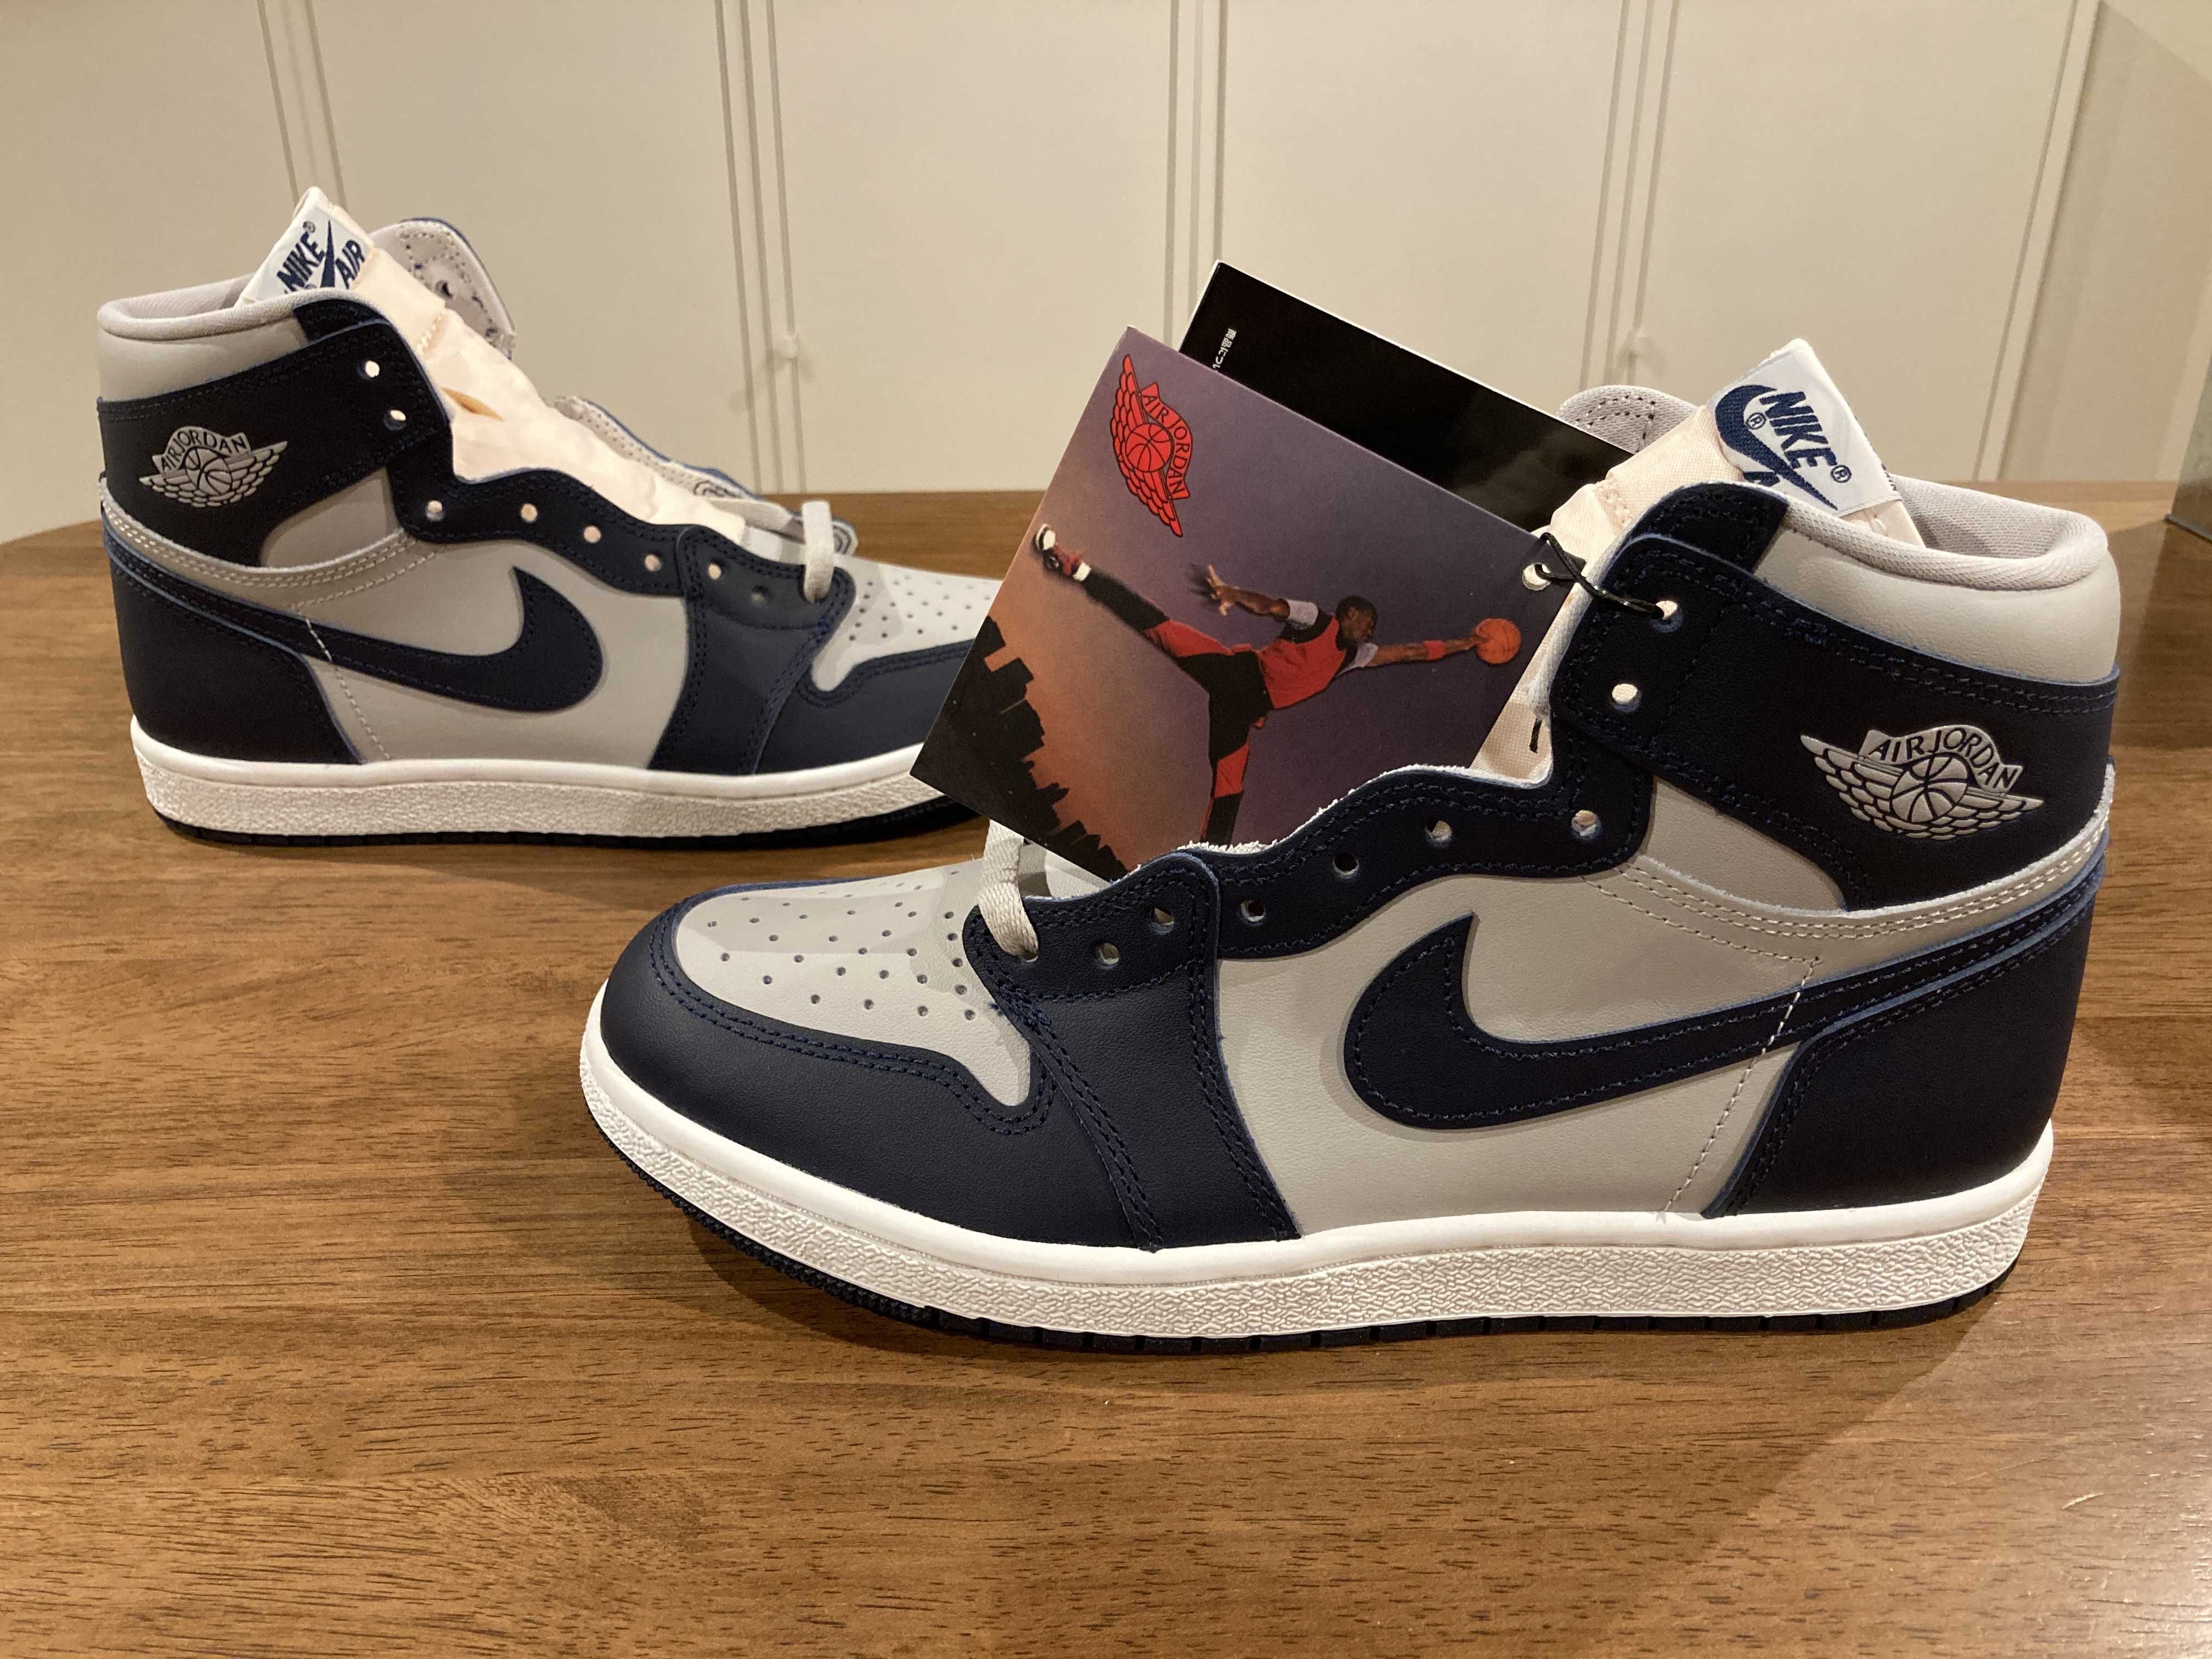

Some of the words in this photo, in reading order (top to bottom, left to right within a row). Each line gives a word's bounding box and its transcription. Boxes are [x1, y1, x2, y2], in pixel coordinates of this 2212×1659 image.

[335, 240, 365, 289] AIR
[161, 447, 181, 471] AIR
[173, 430, 247, 454] JORDAN
[1143, 394, 1168, 424] AIR
[1168, 419, 1190, 494] JORDAN
[1759, 391, 1838, 469] NIKE
[1869, 736, 1923, 760] AIR
[1929, 727, 2018, 789] JORDAN
